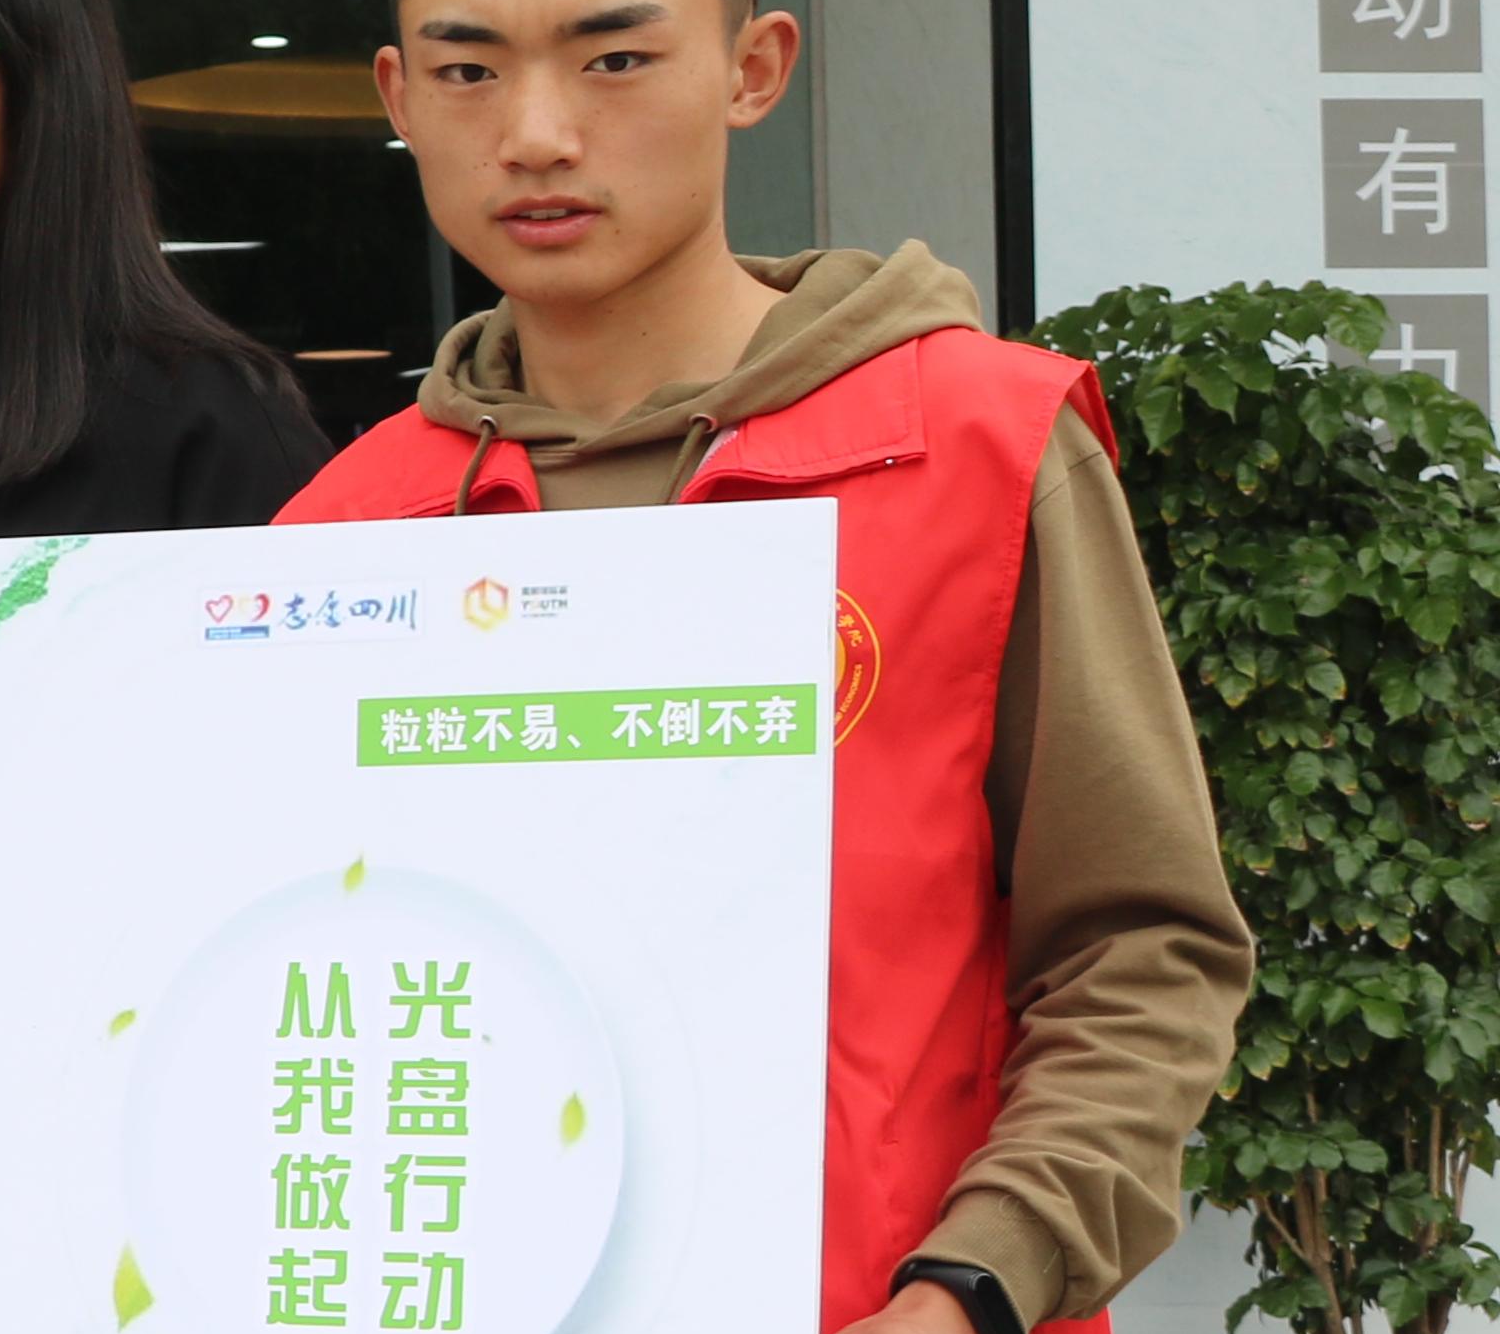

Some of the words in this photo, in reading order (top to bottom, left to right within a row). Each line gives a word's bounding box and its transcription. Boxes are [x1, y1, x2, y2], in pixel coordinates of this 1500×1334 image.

[380, 695, 799, 753] 粒粒不易、不倒不弃
[266, 960, 357, 1328] 从我做起
[380, 960, 473, 1332] 光盘行动
